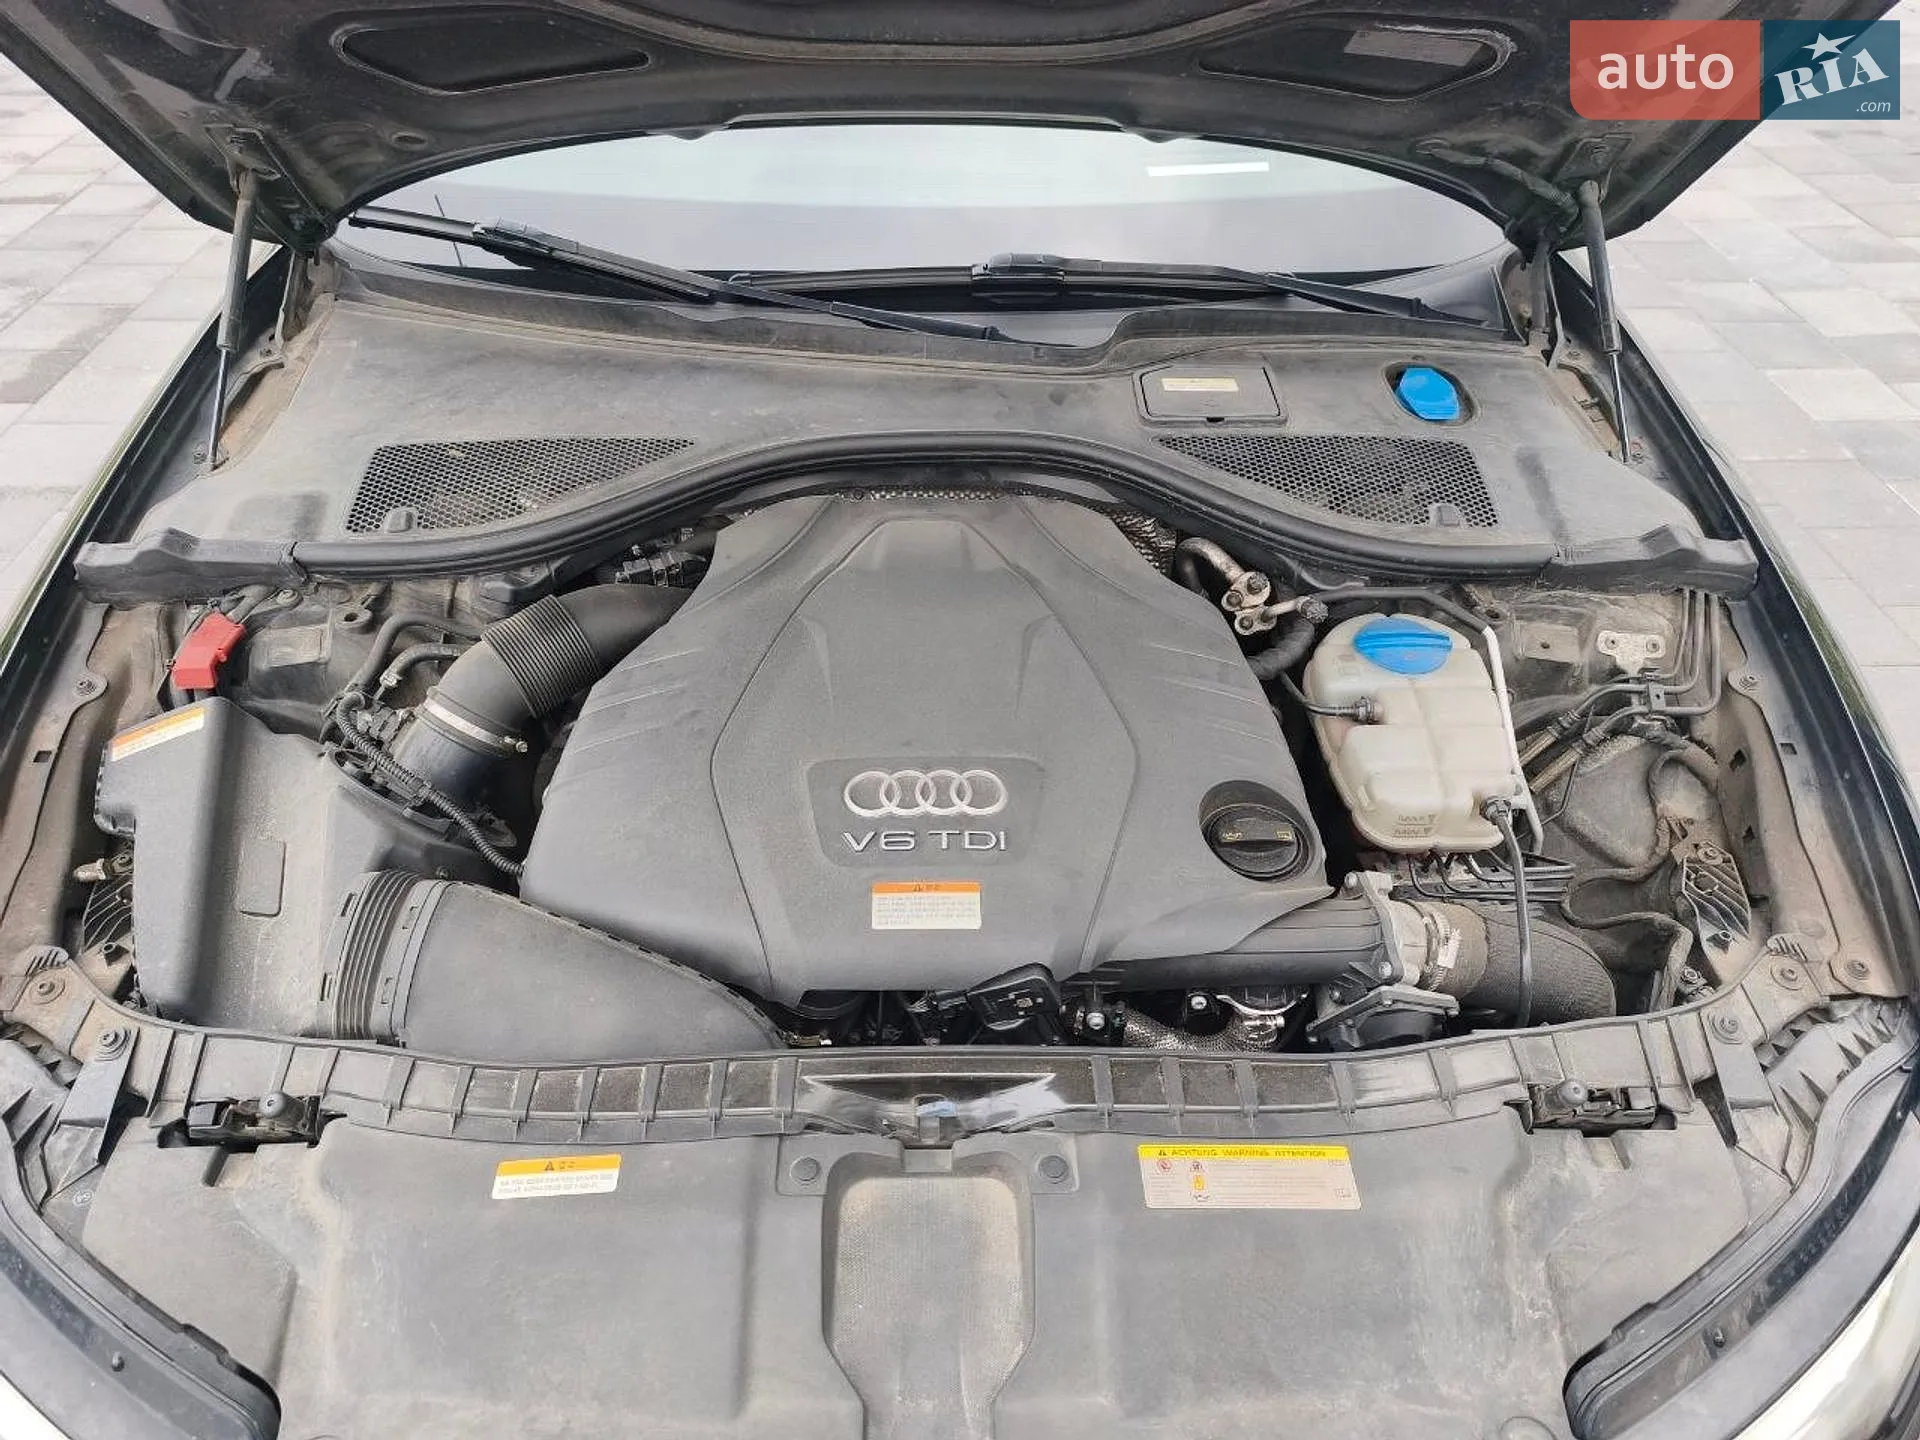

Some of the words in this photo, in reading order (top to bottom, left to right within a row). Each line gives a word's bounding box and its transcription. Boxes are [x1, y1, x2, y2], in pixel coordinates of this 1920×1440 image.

[843, 831, 916, 852] V6
[928, 831, 1008, 850] TDI
[1223, 1149, 1270, 1157] WARNING
